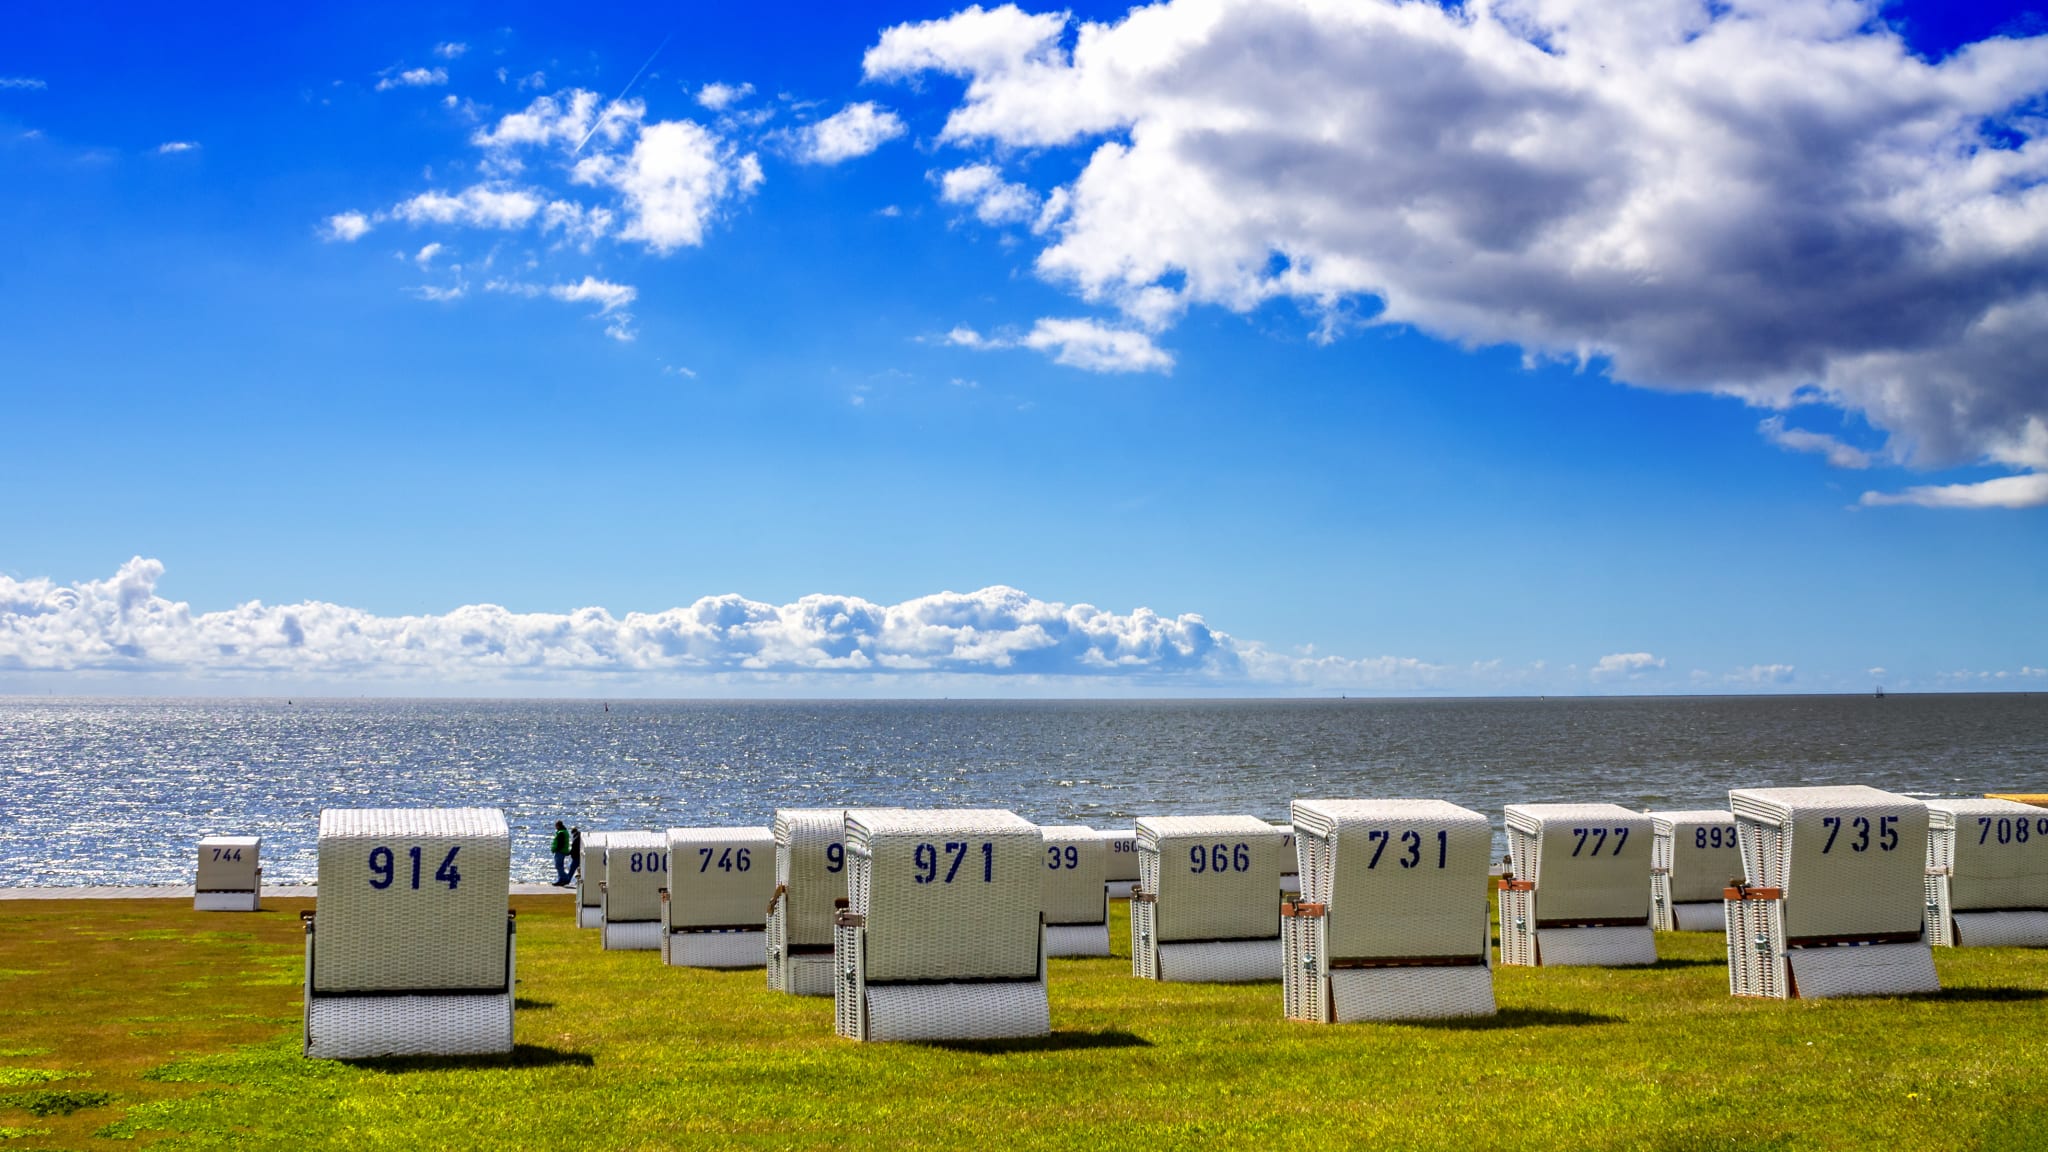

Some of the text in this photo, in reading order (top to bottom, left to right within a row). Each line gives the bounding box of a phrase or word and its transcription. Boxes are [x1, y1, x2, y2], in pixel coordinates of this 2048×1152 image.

[1367, 830, 1447, 869] 731
[1572, 827, 1629, 857] 777
[1695, 826, 1736, 849] 893
[1822, 816, 1898, 854] 735
[212, 848, 242, 862] 744
[368, 846, 461, 890] 914
[699, 847, 751, 873] 746
[914, 842, 993, 884] 971
[1190, 843, 1250, 873] 966
